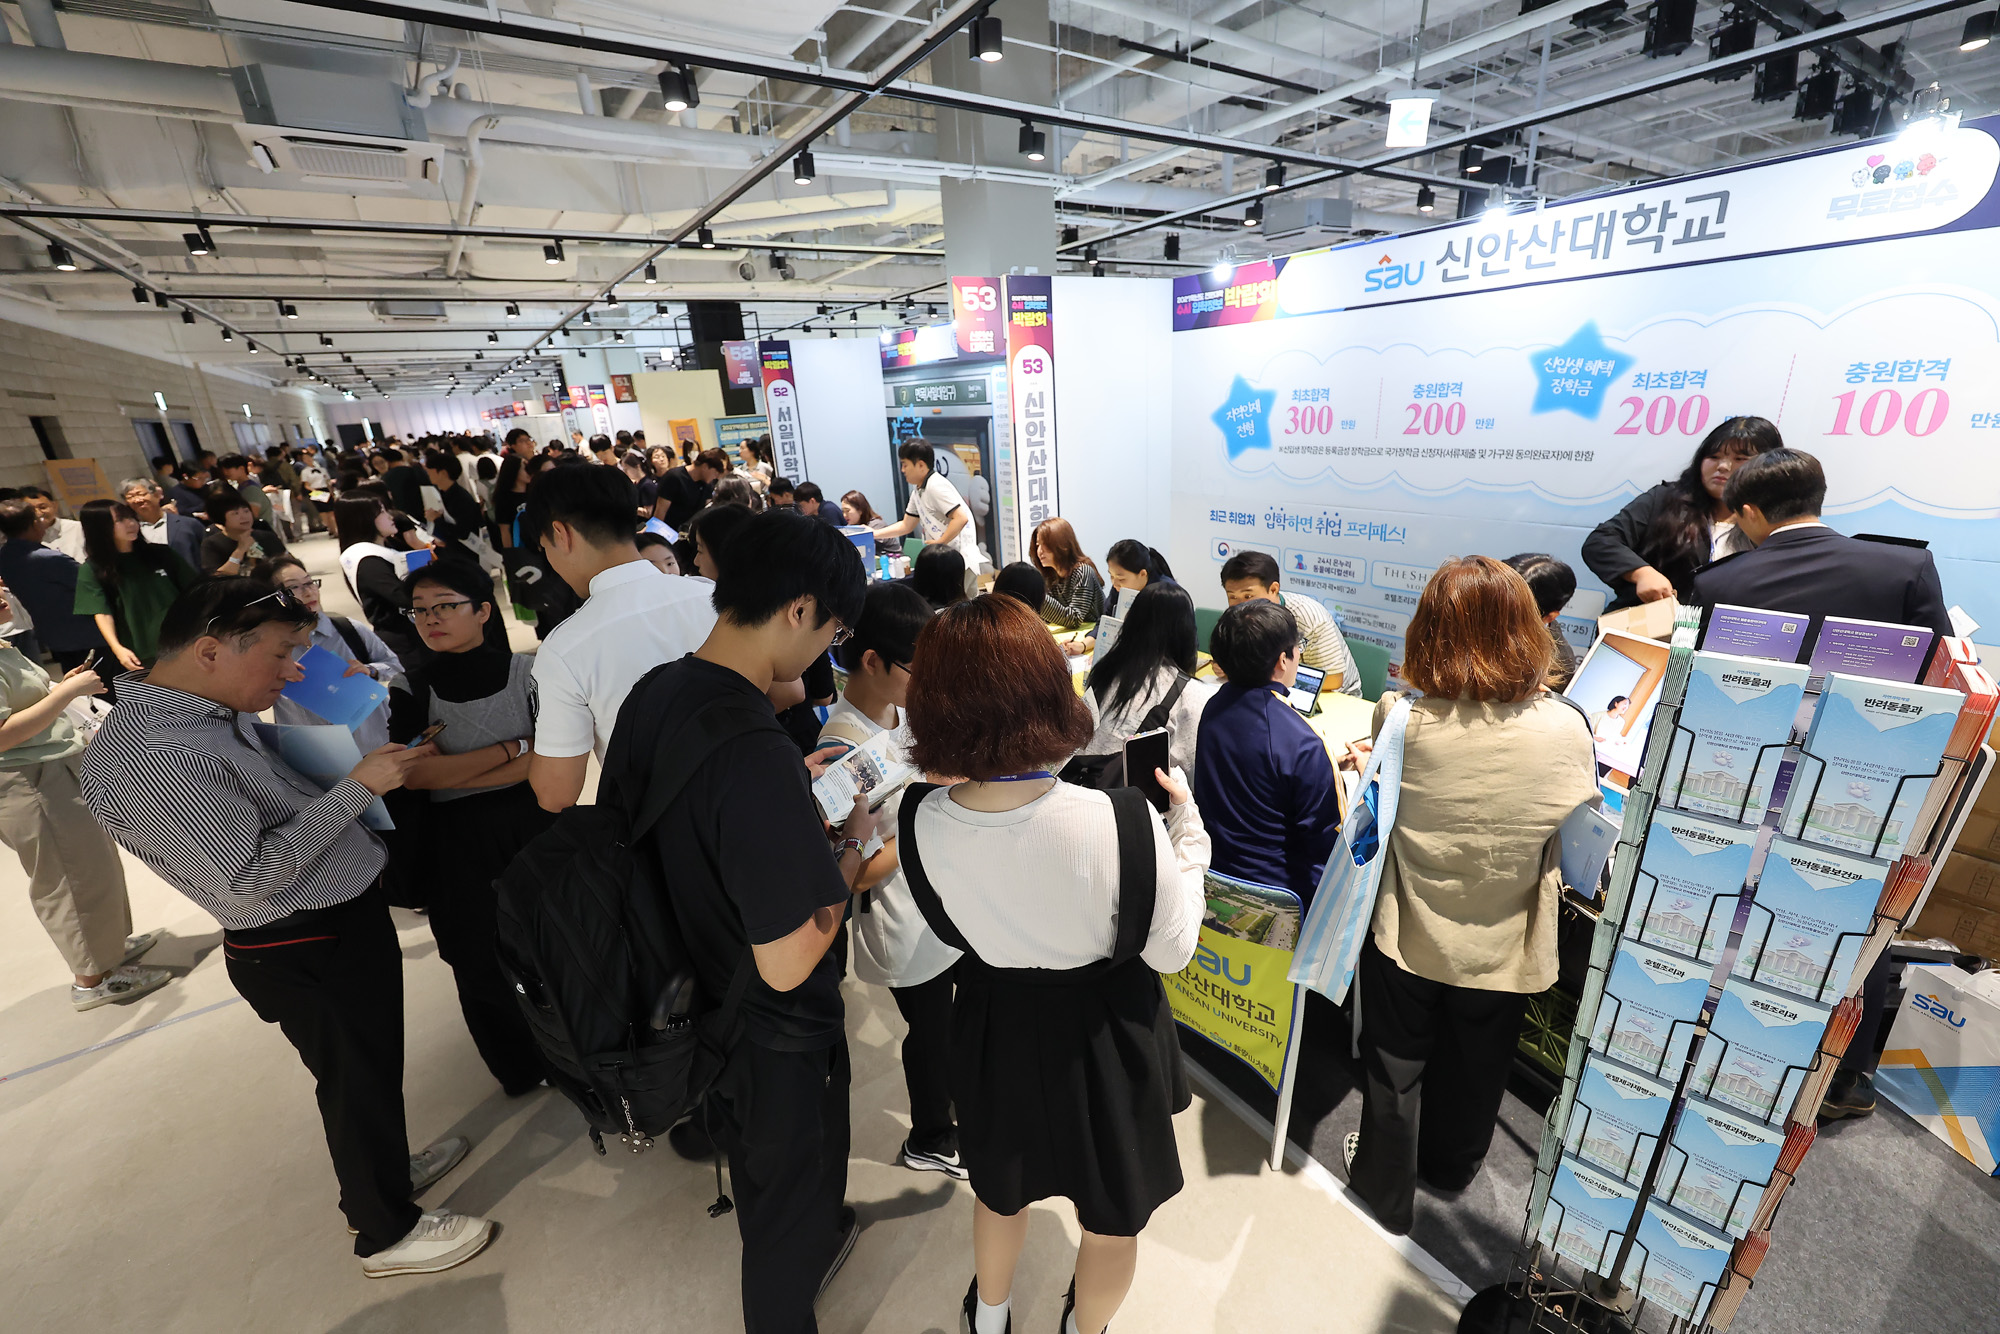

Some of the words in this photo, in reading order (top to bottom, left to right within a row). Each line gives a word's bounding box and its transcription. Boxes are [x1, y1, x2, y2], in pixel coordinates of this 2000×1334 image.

[1826, 179, 1960, 221] 무료접수
[1436, 189, 1731, 283] 신안산대학교
[1364, 255, 1425, 293] sau
[961, 285, 997, 311] 53
[1224, 278, 1278, 308] 박람회
[1176, 302, 1192, 316] 수시
[1192, 297, 1224, 313] 입학정보
[1012, 311, 1048, 327] 박람회
[729, 345, 754, 361] 52
[1022, 358, 1044, 375] 53
[1543, 356, 1584, 375] 신입생
[1584, 359, 1616, 377] 혜택
[1844, 358, 1952, 384] 충원합격
[614, 376, 630, 387] 51
[1412, 381, 1464, 399] 충원합격
[1550, 377, 1594, 397] 장학금
[1632, 369, 1708, 390] 최초합격
[571, 387, 585, 396] 51
[773, 387, 789, 397] 52
[1291, 387, 1330, 403] 최초합격
[1226, 398, 1261, 422] 지역인재
[1284, 405, 1333, 435] 300
[1341, 419, 1356, 430] 만원
[1402, 401, 1466, 435] 200
[1475, 417, 1495, 430] 만원
[1613, 394, 1710, 436] 200
[1822, 387, 1950, 437] 100
[1236, 419, 1255, 439] 전형
[1300, 445, 1324, 455] 장학금은
[1351, 446, 1384, 456] 장학금으로
[1384, 447, 1419, 458] 국가장학금
[1478, 448, 1486, 460] 및
[1487, 449, 1515, 460] 가구원
[1515, 449, 1573, 462] 동의완료자)에
[1574, 450, 1595, 463] 한함
[1209, 509, 1227, 523] 최근
[1228, 511, 1256, 527] 취업처
[1264, 510, 1313, 534] 입학하면
[1315, 516, 1342, 537] 취업
[1343, 521, 1406, 545] 프리패스!
[1313, 565, 1356, 579] 동물메디컬센터
[1317, 556, 1331, 566] 24시
[1332, 558, 1352, 569] 온누리
[1289, 576, 1328, 591] 반려동물보건과
[1384, 592, 1417, 606] 호텔조리과
[1721, 673, 1772, 689] 반려동물과
[1864, 698, 1923, 716] 반려동물과
[1671, 826, 1734, 846] 반려동물보건과
[1790, 857, 1863, 881] 반려동물보건과
[1191, 940, 1252, 986] au
[1643, 958, 1686, 978] 호텔조리과
[1175, 982, 1210, 1011] ANSAN
[1212, 1007, 1283, 1049] UNIVERSITY
[1749, 999, 1798, 1020] 호텔조리과
[1912, 993, 1967, 1028] sau
[1209, 1031, 1233, 1048] sau
[1604, 1073, 1657, 1097] 호텔제과제빵과
[1706, 1116, 1765, 1143] 호텔제과제빵과
[1573, 1171, 1623, 1198] 바이오식품학과
[1660, 1218, 1715, 1249] 바이오식품학과
